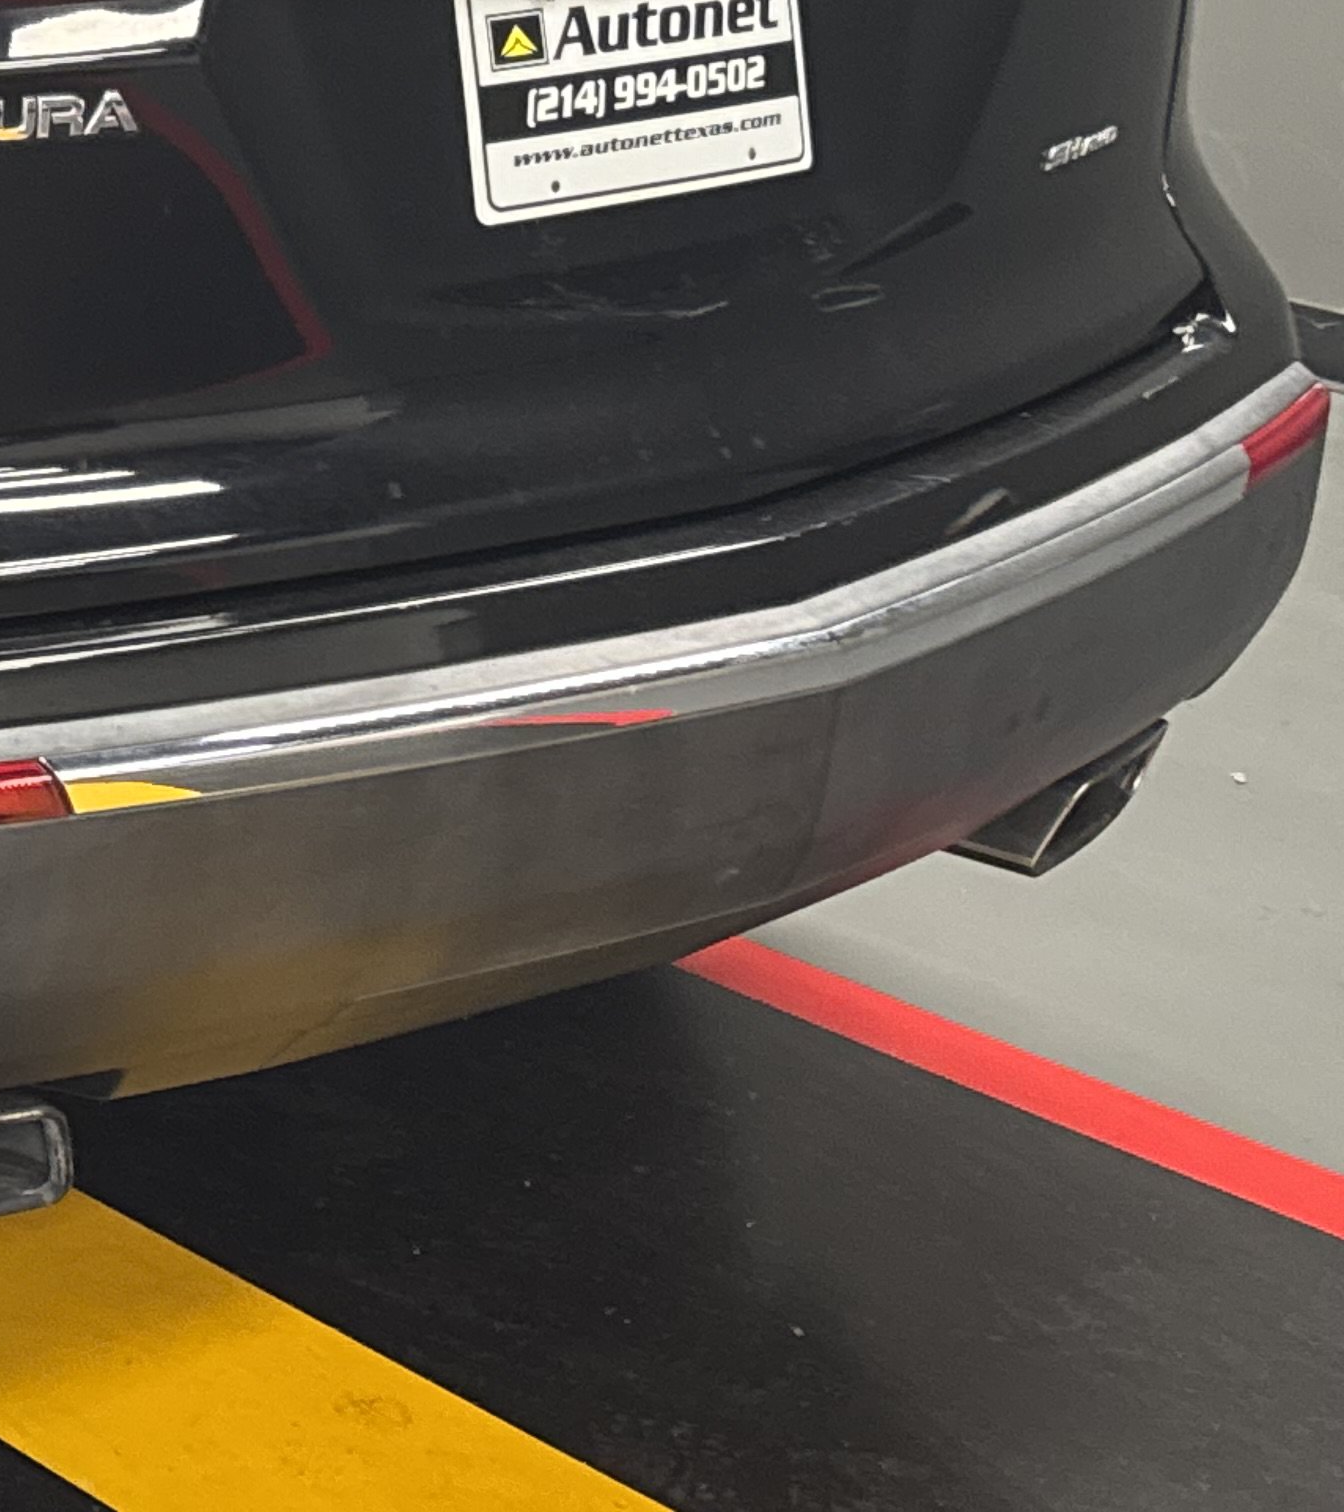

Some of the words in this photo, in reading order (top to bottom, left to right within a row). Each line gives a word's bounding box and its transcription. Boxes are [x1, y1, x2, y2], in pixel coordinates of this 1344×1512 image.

[526, 78, 606, 129] (214)
[613, 54, 766, 111] 994-0502
[513, 112, 782, 168] www.autonettexas.com
